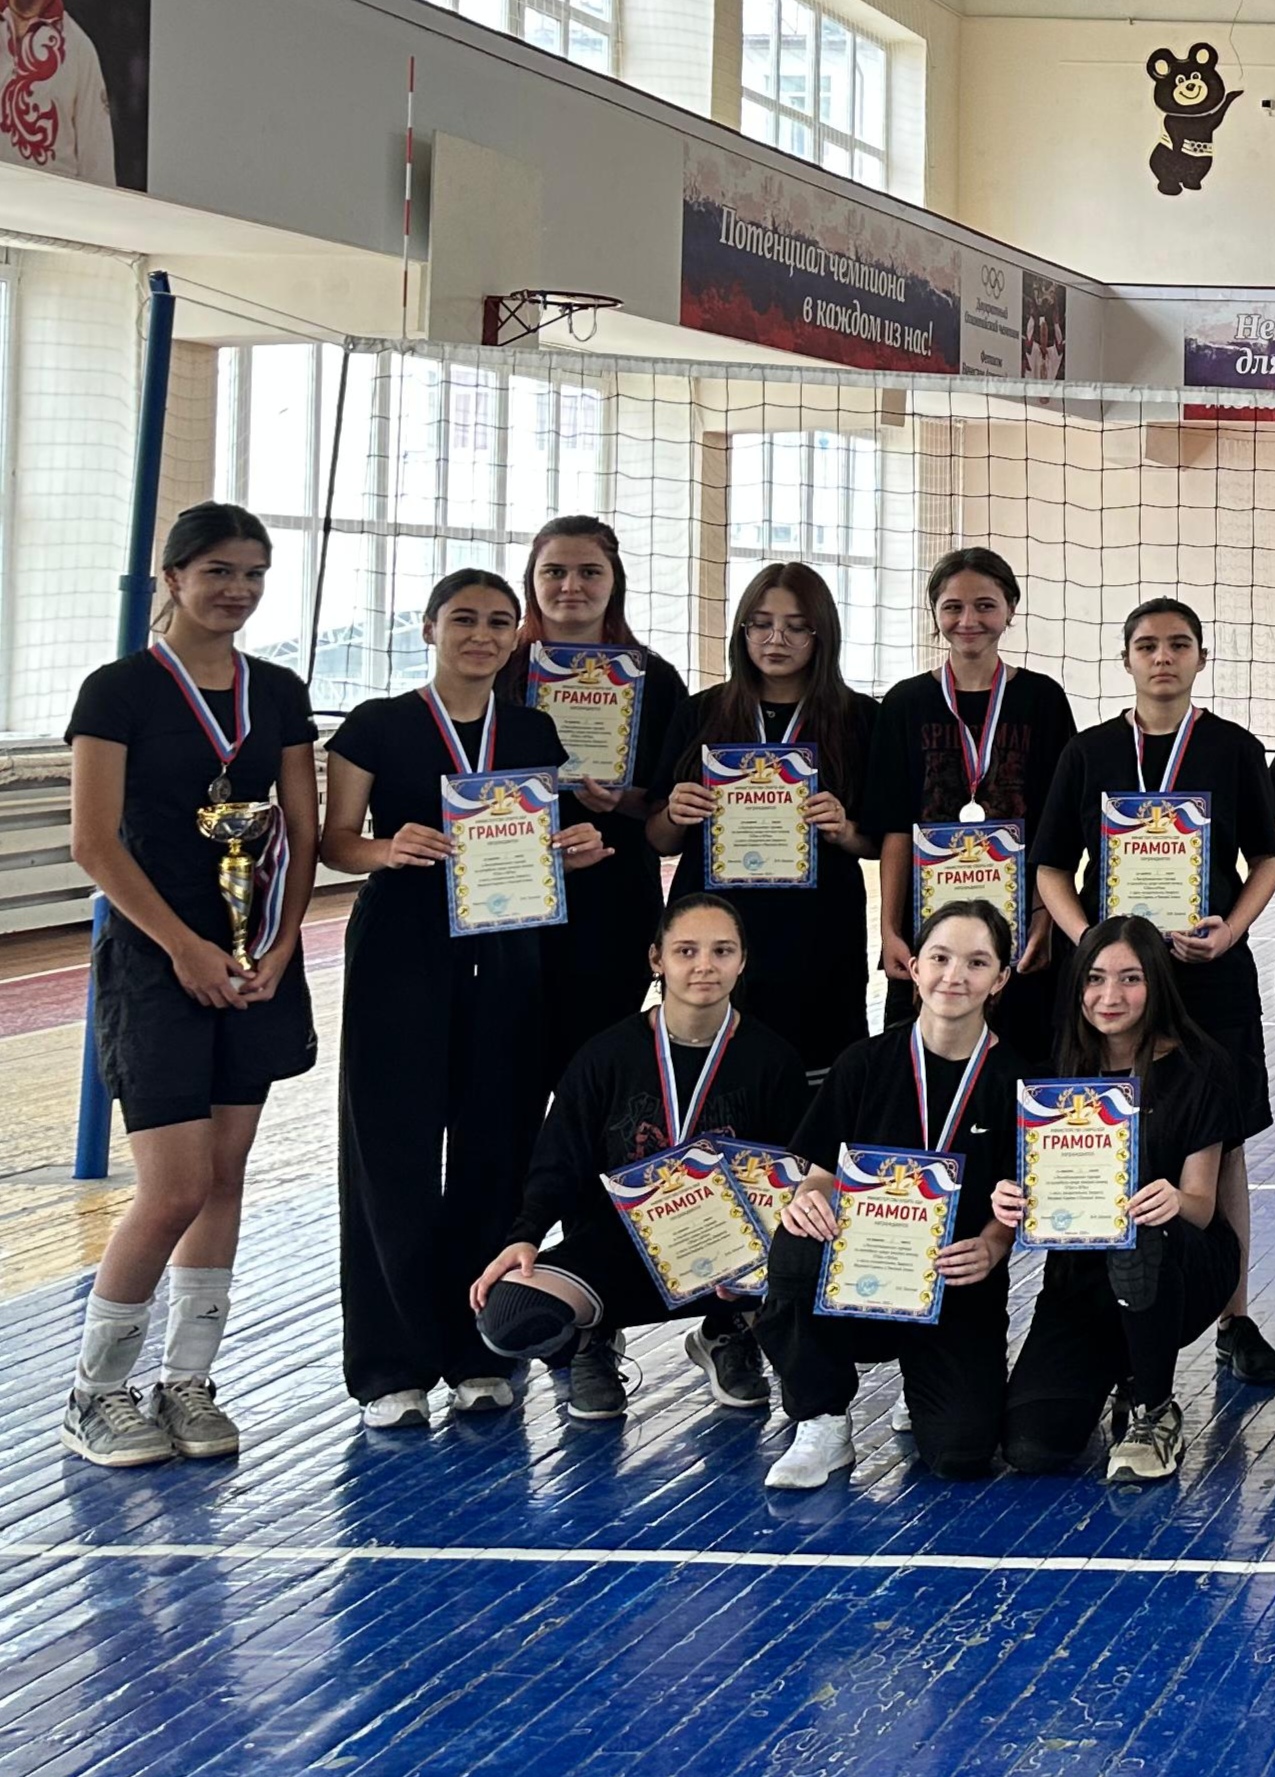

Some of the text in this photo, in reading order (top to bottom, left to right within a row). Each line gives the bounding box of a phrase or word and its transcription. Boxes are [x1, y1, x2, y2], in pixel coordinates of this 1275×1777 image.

[719, 205, 906, 303] Потенциал чемпиона
[803, 296, 933, 356] в каждом из нас!
[1235, 313, 1275, 341] Не
[554, 690, 618, 705] ГРАМОТА
[727, 790, 793, 804] ГРАМОТА
[468, 821, 535, 840] ГРАМОТА
[1124, 841, 1187, 855] ГРАМОТА
[937, 868, 1001, 884] ГРАМОТА
[1042, 1134, 1112, 1150] ГРАМОТА
[646, 1185, 715, 1222] ГРАМОТА
[856, 1201, 928, 1222] ГРАМОТА
